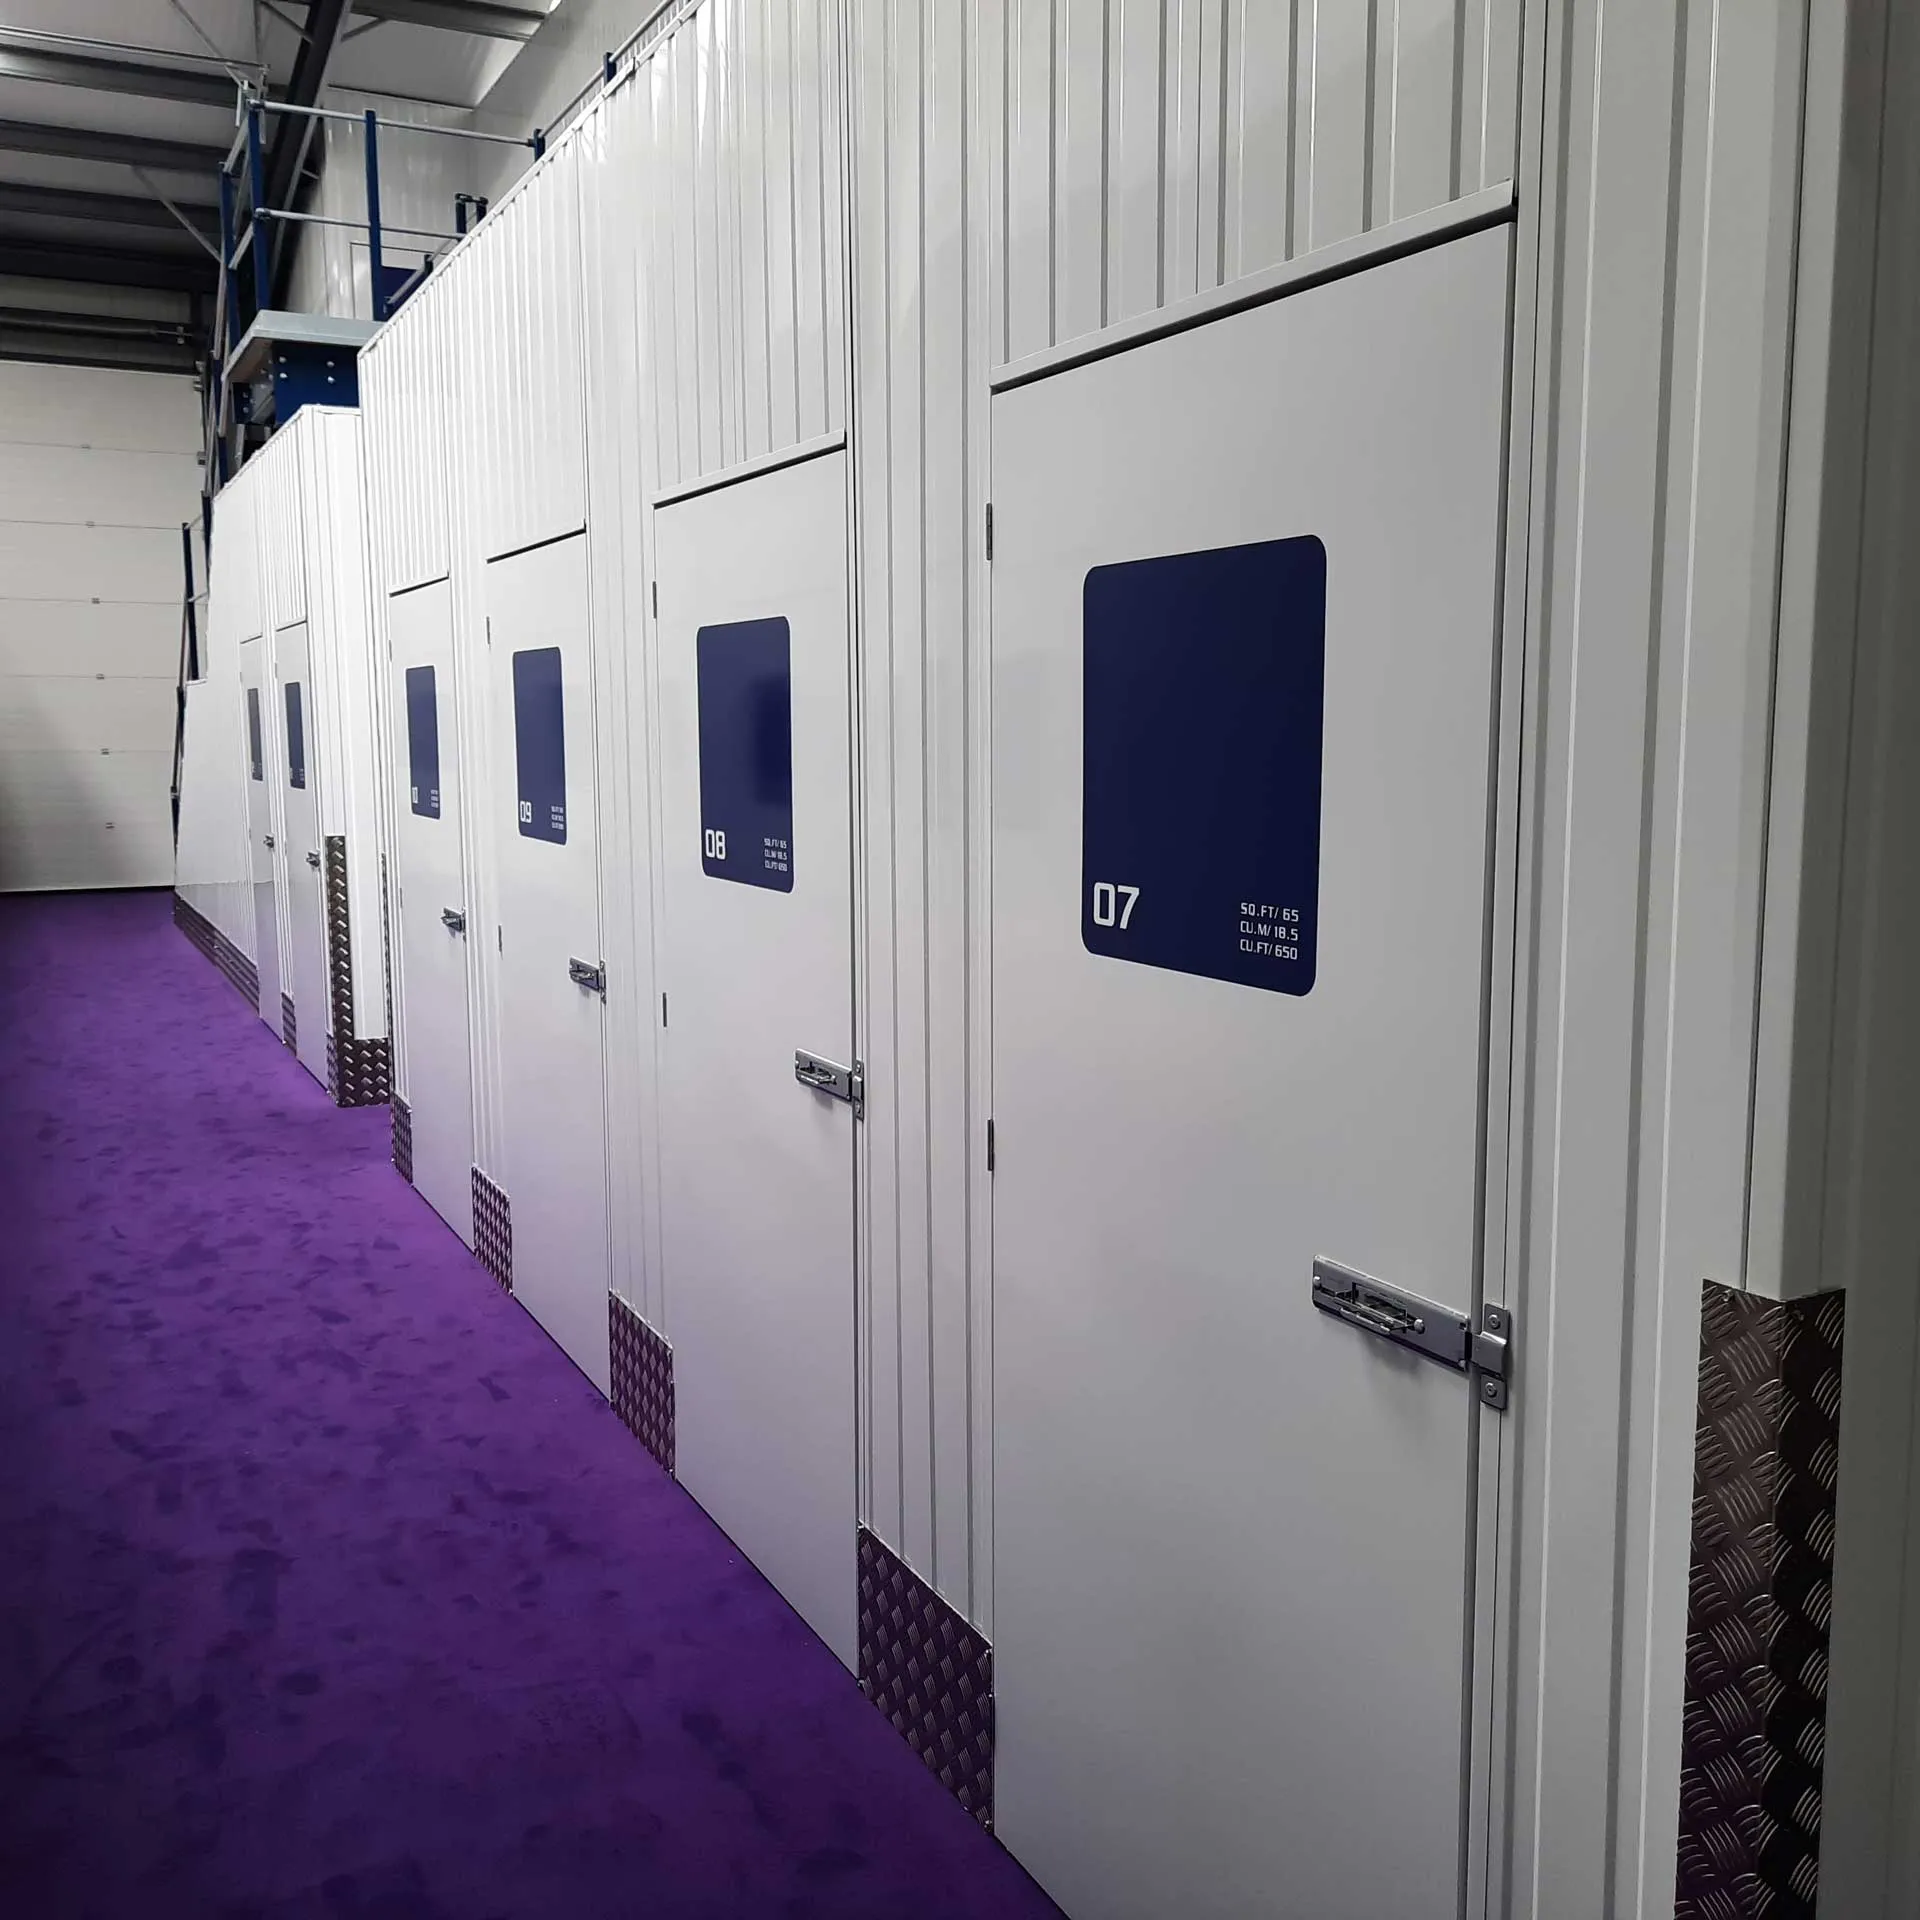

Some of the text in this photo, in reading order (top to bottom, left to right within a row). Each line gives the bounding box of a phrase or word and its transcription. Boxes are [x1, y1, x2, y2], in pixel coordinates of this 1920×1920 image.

[520, 800, 532, 823] 09
[705, 829, 726, 860] 08
[1093, 882, 1140, 930] 07
[1282, 908, 1299, 922] 65
[1240, 920, 1298, 941] CU.M/ 18.5
[1240, 938, 1298, 960] CU.FT/ 650
